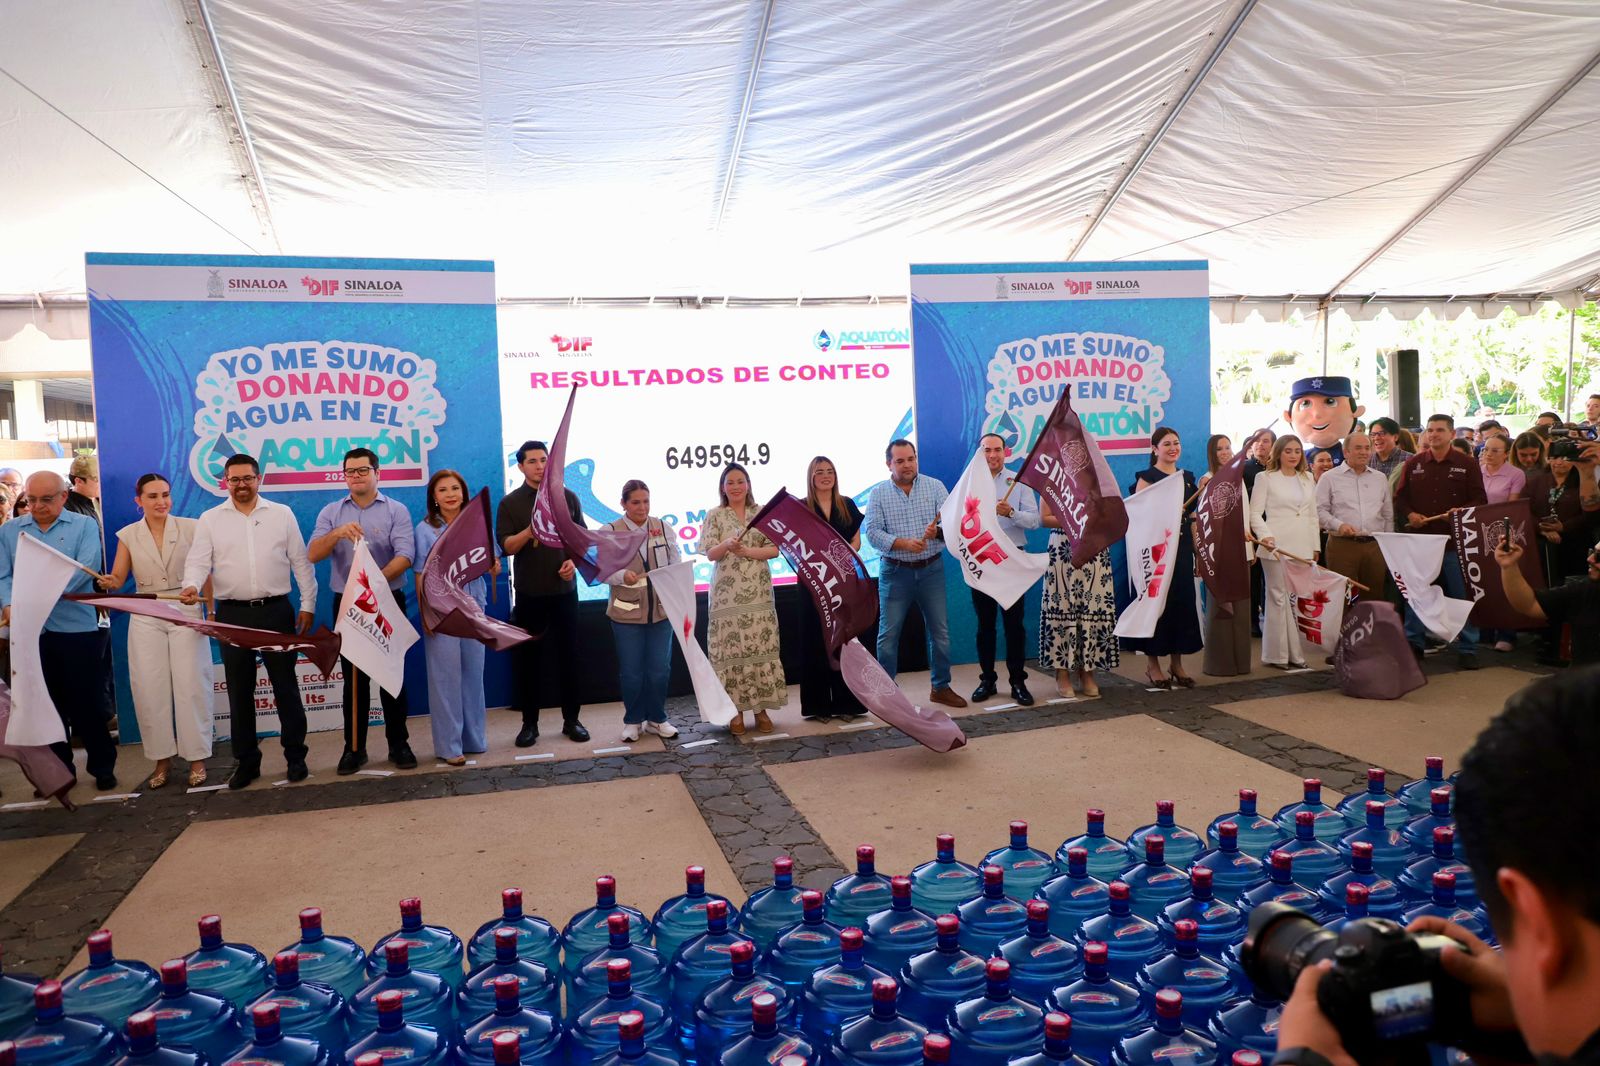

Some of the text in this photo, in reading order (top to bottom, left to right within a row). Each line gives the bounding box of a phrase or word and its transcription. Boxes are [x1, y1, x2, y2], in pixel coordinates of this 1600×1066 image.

[228, 279, 288, 289] SINALOA
[308, 278, 403, 296] DIF SINALOA
[1011, 282, 1055, 291] SINALOA
[1070, 280, 1140, 294] DIF SINALOA
[557, 336, 593, 352] DIF
[1004, 337, 1150, 365] YO ME SUMO
[218, 347, 417, 379] YO ME SUMO
[530, 363, 889, 389] RESULTADOS DE CONTEO
[1017, 358, 1143, 385] DONANDO
[237, 373, 409, 402] DONANDO
[1008, 382, 1138, 410] AGUA EN EL
[225, 400, 403, 433] AGUA EN EL
[665, 442, 770, 469] 649594.9
[325, 473, 345, 481] 202
[1461, 507, 1486, 601] NALOA
[810, 579, 822, 595] DEL
[346, 607, 390, 653] SINALOA
